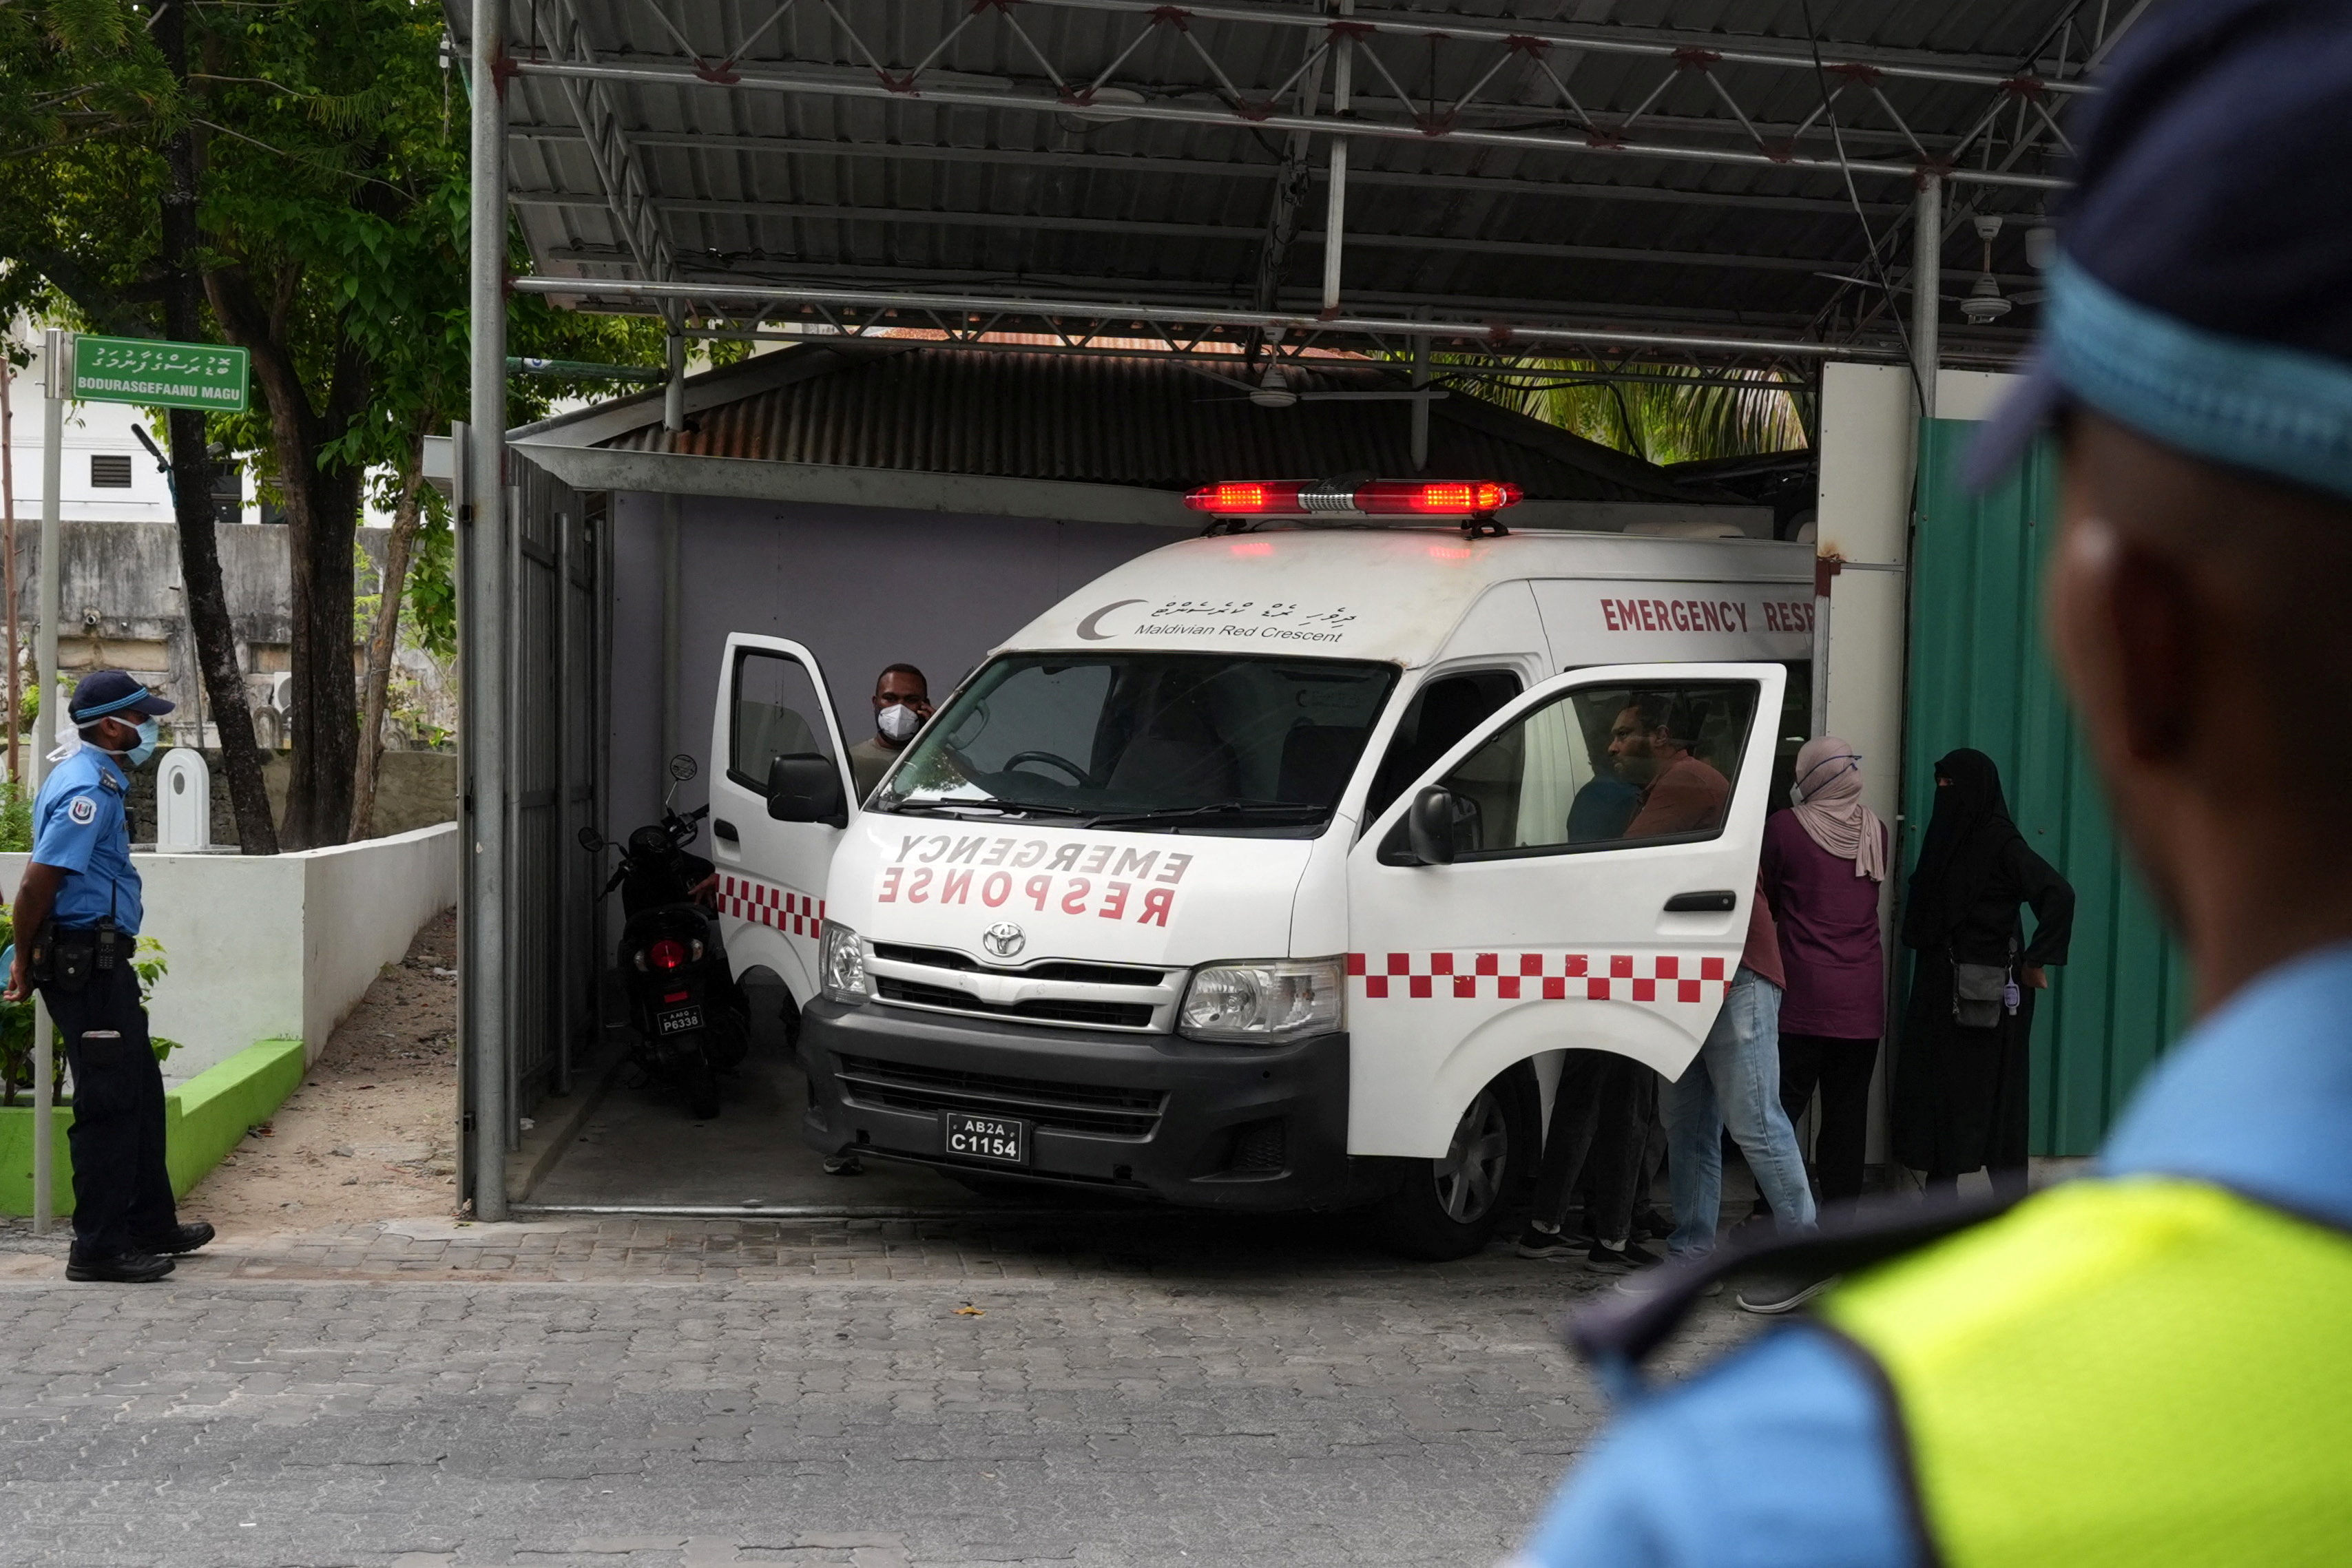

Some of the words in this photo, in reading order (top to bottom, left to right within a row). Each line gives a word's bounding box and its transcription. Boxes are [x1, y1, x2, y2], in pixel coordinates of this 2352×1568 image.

[77, 376, 198, 397] BODURASGEFAANU
[201, 386, 240, 401] MAGU
[1600, 598, 1748, 632] EMERGENCY
[1134, 624, 1215, 636] Maldivian
[1218, 625, 1265, 638] Red
[1261, 627, 1343, 643] Crescent
[663, 1016, 698, 1032] P6338
[964, 1120, 1005, 1136] AB2A
[951, 1133, 1017, 1157] C1154
